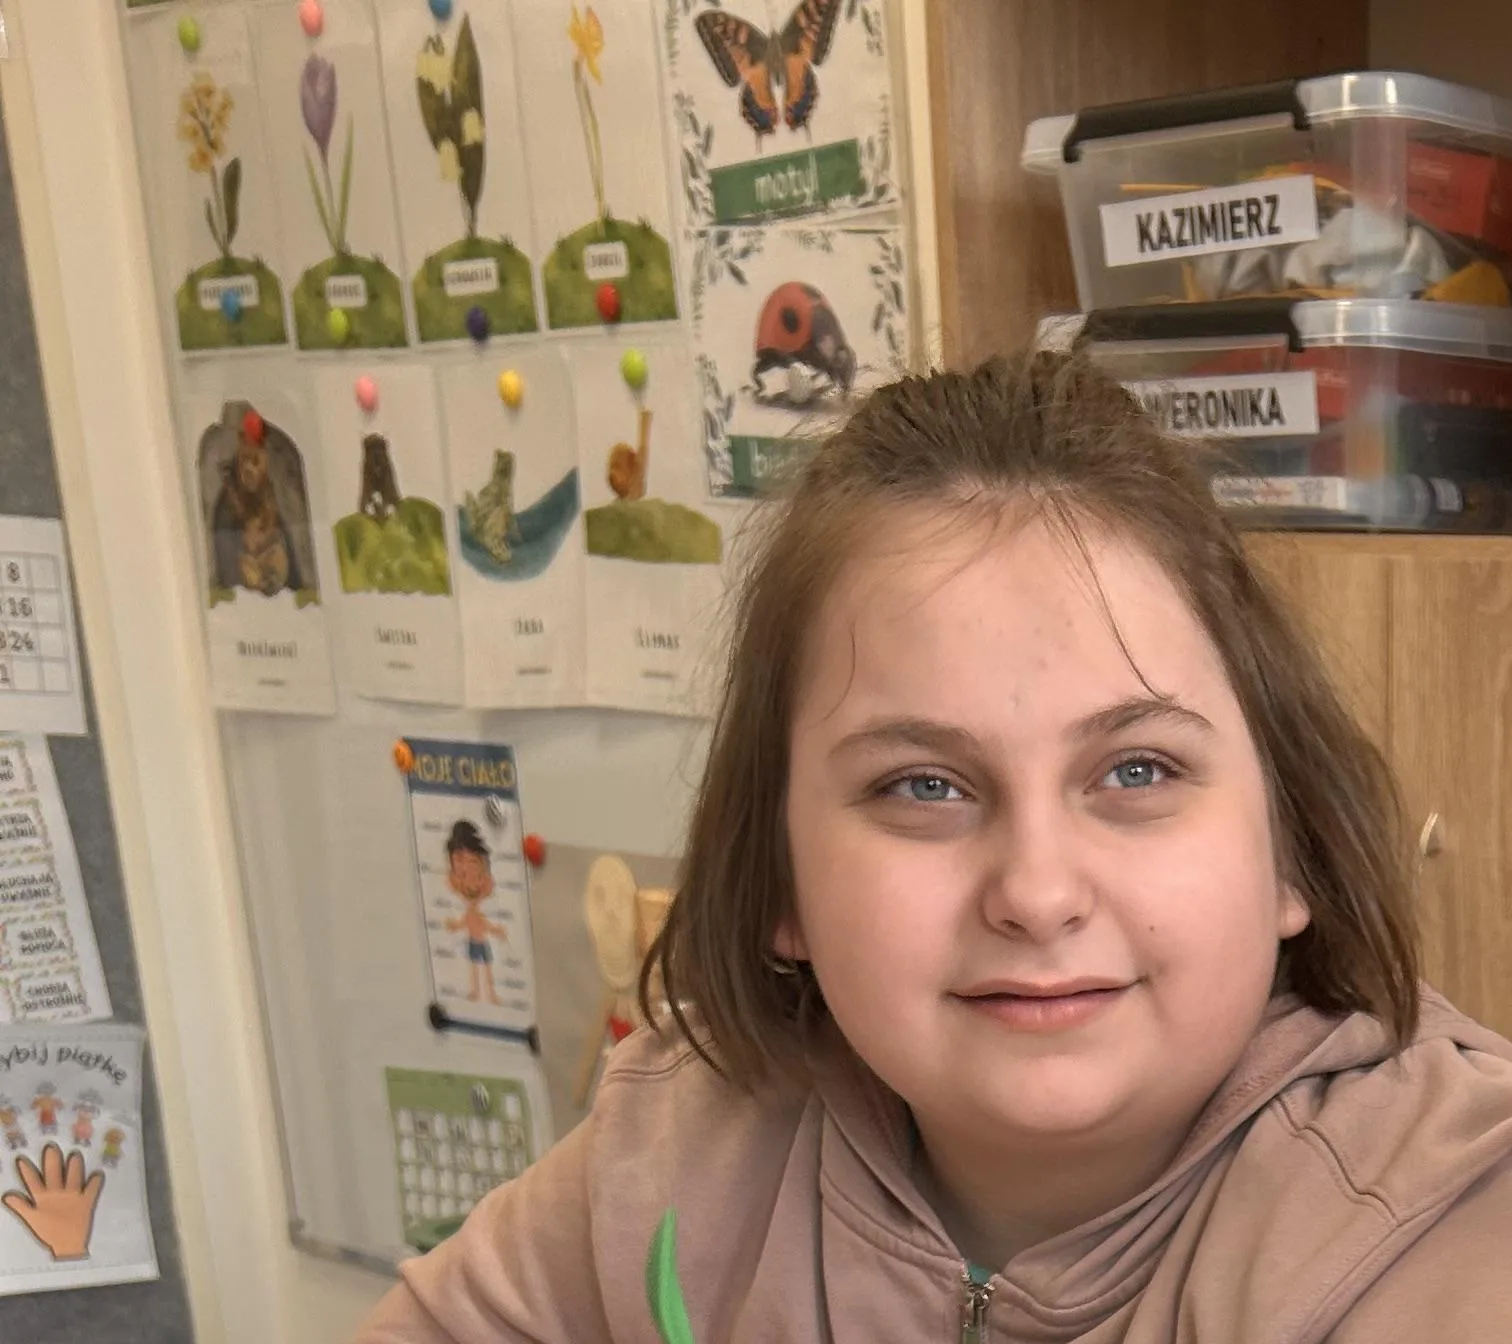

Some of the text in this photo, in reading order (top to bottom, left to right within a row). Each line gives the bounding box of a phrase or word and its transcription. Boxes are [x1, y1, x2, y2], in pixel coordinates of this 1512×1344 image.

[755, 151, 819, 204] motyl
[1136, 194, 1283, 253] KAZIMIERZ
[458, 756, 515, 788] CIAŁO
[0, 1041, 48, 1071] ybij
